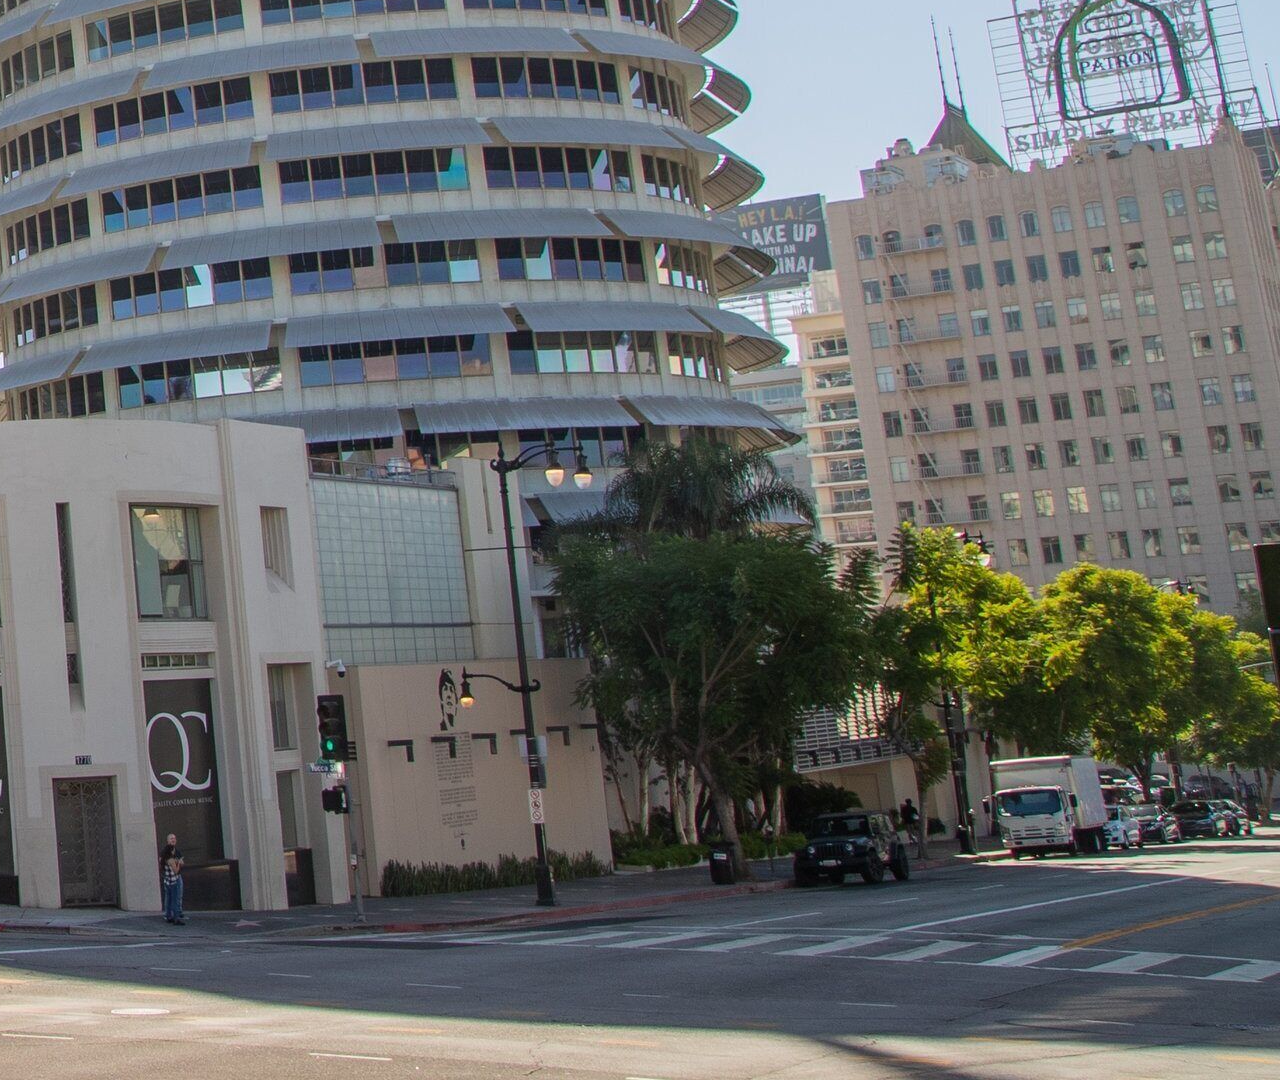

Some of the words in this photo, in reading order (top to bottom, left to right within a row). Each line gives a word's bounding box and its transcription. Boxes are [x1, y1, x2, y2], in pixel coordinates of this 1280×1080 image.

[1079, 49, 1154, 74] PATRÓN
[738, 208, 766, 228] HEY
[793, 223, 817, 243] UP
